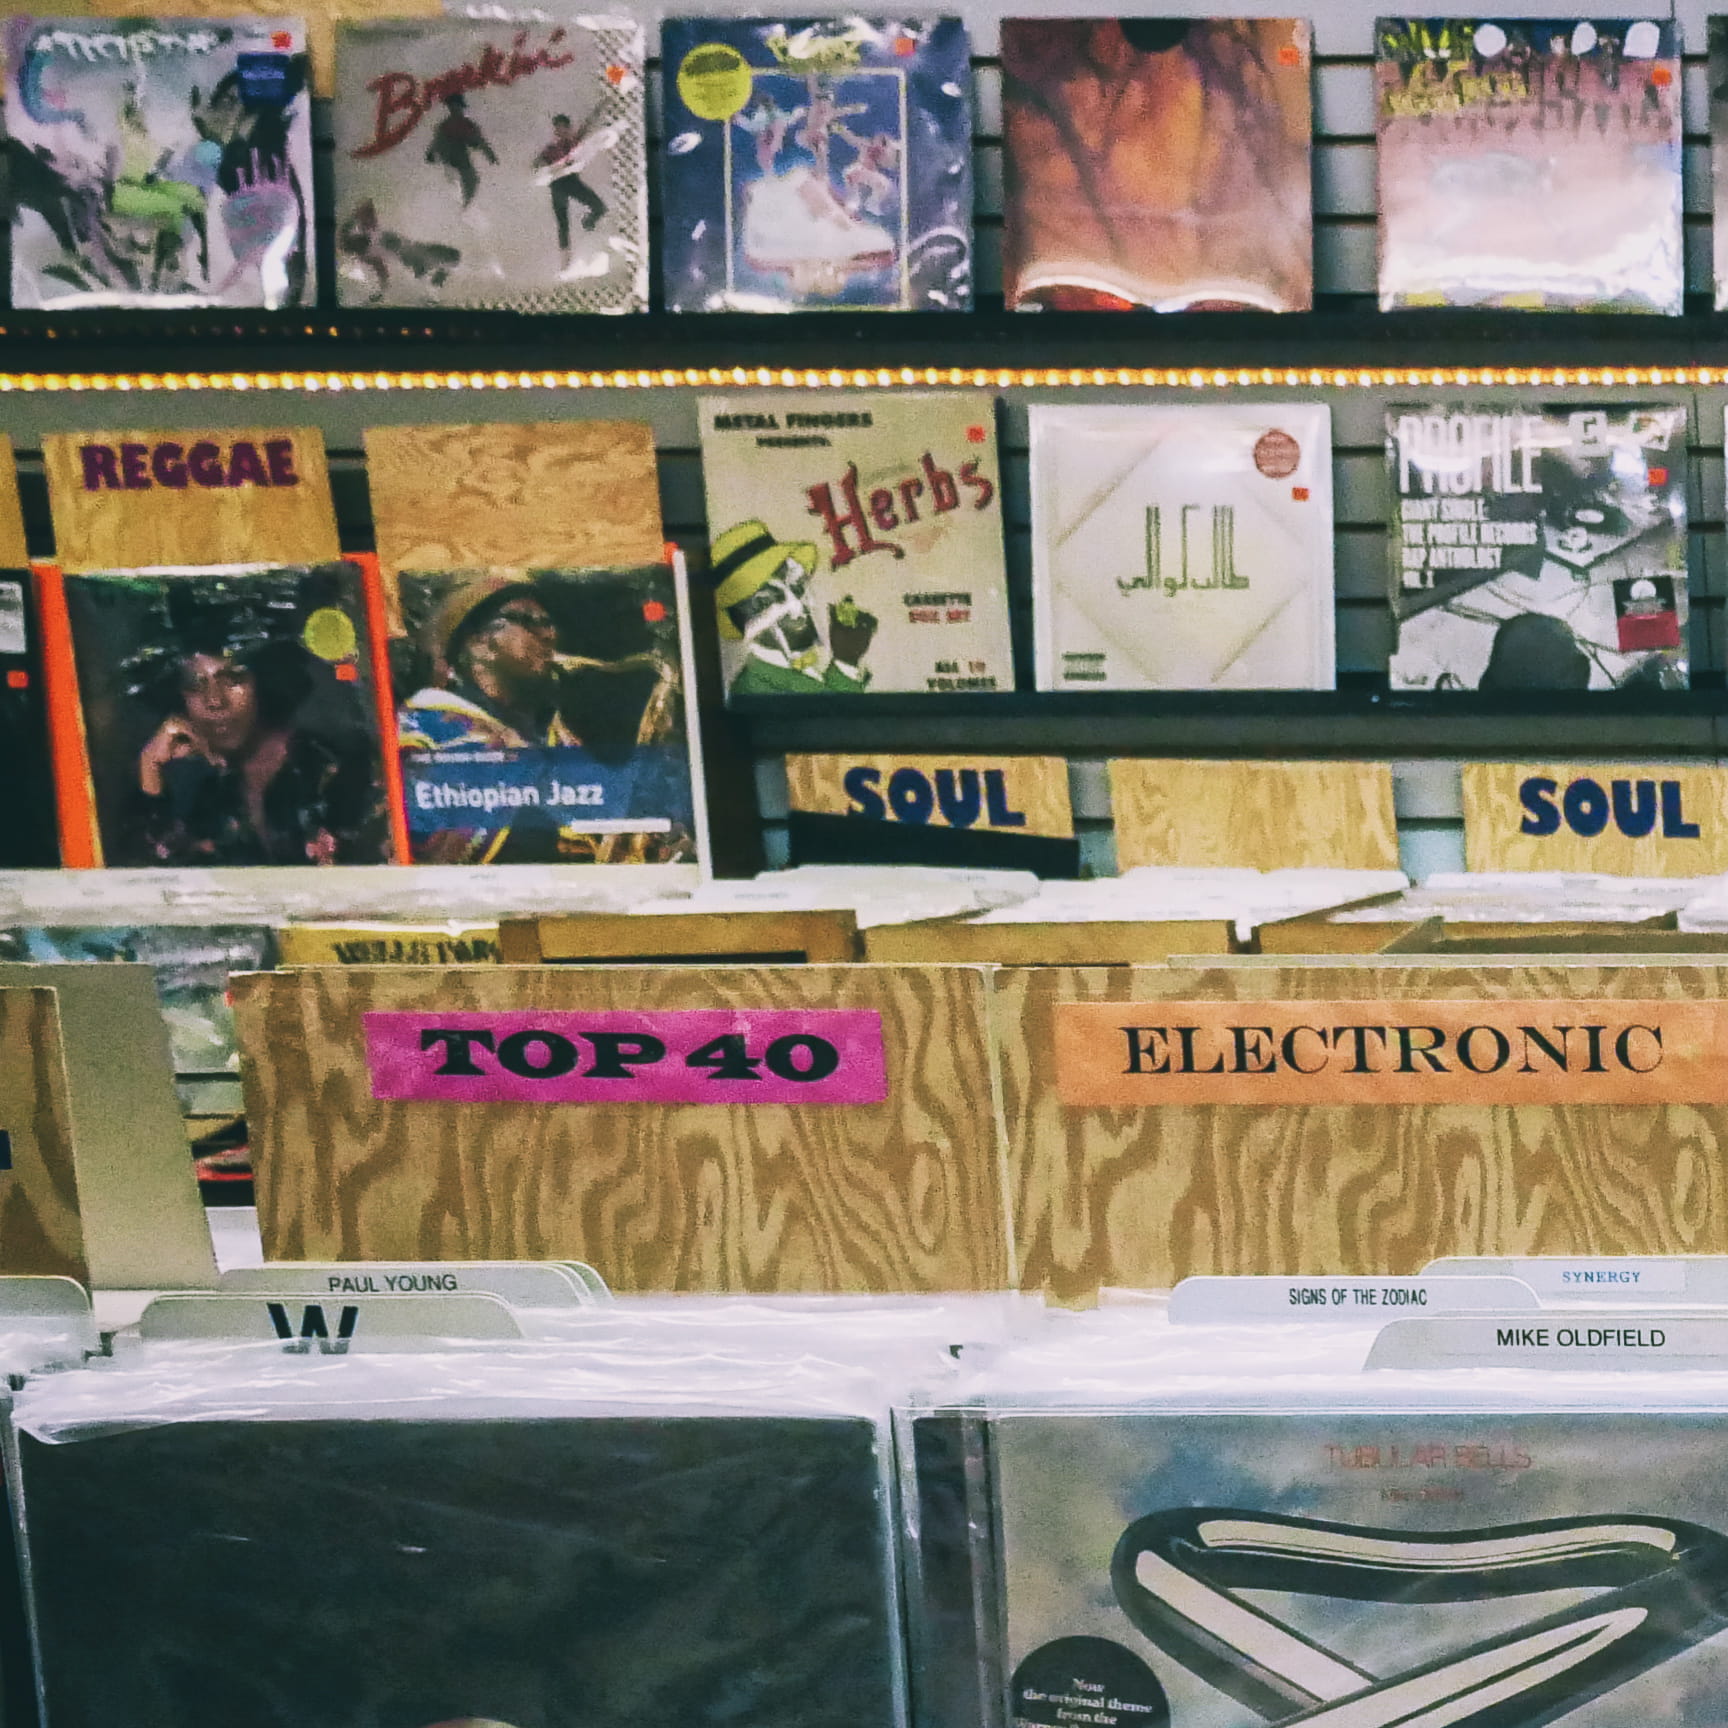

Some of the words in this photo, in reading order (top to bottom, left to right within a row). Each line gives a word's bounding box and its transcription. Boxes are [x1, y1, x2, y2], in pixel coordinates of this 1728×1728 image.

[81, 438, 299, 491] REGGAE
[1399, 414, 1543, 495] PROFILE
[806, 452, 995, 571] Herbs
[415, 778, 540, 811] Ethiopian
[546, 780, 605, 806] Jazz
[843, 767, 1026, 829] SOUL
[1519, 777, 1700, 840] SOUL
[419, 1029, 669, 1080] TOP
[685, 1032, 840, 1082] 40
[1119, 1024, 1665, 1077] ELECTRONIC
[327, 1276, 381, 1293] PAUL
[383, 1273, 458, 1292] YOUNG
[1289, 1287, 1327, 1306] SIGNS
[1331, 1287, 1348, 1306] OF
[1352, 1288, 1378, 1306] THE
[1381, 1288, 1428, 1306] ZODIAC
[1562, 1271, 1640, 1283] SYNERGY
[266, 1301, 360, 1355] W
[1496, 1328, 1550, 1347] MIKE
[1556, 1328, 1666, 1347] OLDFIELD
